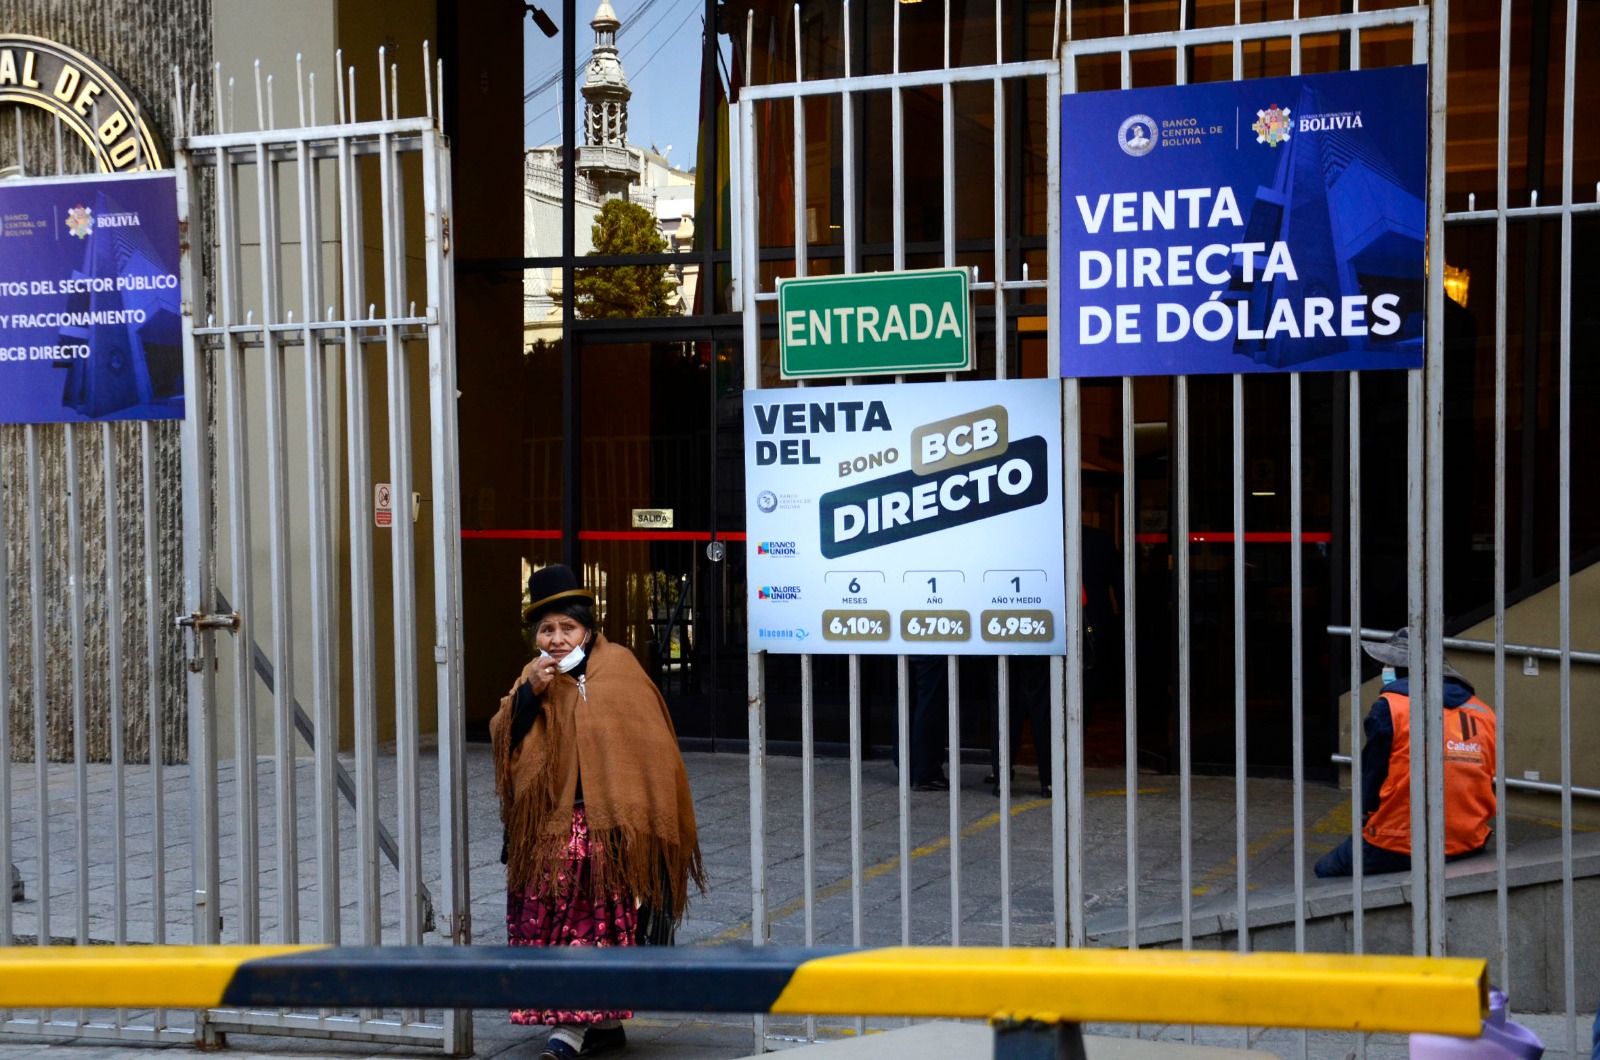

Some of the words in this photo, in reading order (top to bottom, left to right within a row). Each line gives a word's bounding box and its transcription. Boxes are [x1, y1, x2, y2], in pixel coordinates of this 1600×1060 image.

[54, 64, 101, 116] DE
[98, 110, 147, 172] BO
[1162, 118, 1197, 128] BANCO
[1299, 115, 1363, 132] BOLIVIA
[1162, 127, 1206, 138] CENTRAL
[1209, 125, 1223, 134] DE
[1162, 137, 1201, 147] BOLIVIA
[1075, 186, 1244, 234] VENTA
[97, 215, 141, 228] BOLIVIA
[1079, 241, 1299, 290] DIRECTA
[0, 282, 28, 296] TOS
[31, 280, 57, 295] DEL
[59, 278, 113, 294] SECTOR
[116, 274, 178, 291] PÚBLICO
[0, 315, 9, 328] Y
[12, 309, 147, 328] FRACCIONAMIENTO
[786, 301, 962, 346] ENTRADA
[1079, 304, 1142, 345] DE
[1156, 291, 1402, 343] DÓLARES
[0, 347, 27, 361] BCB
[29, 344, 91, 360] DIRECTO
[753, 400, 893, 435] VENTA
[755, 439, 821, 466] DEL
[838, 447, 900, 478] BONO
[921, 418, 999, 465] BCB
[833, 458, 1034, 543] DIRECTO
[637, 514, 668, 523] SALIDA
[848, 577, 861, 593] 6
[927, 577, 937, 593] 1
[1010, 576, 1020, 593] 1
[926, 595, 943, 604] AÑO
[991, 595, 1008, 604] AÑO
[1010, 596, 1015, 604] Y
[1016, 596, 1042, 604] MEDIO
[829, 617, 883, 636] 6,10%
[907, 617, 964, 636] 6,70%
[987, 617, 1046, 637] 6,95%
